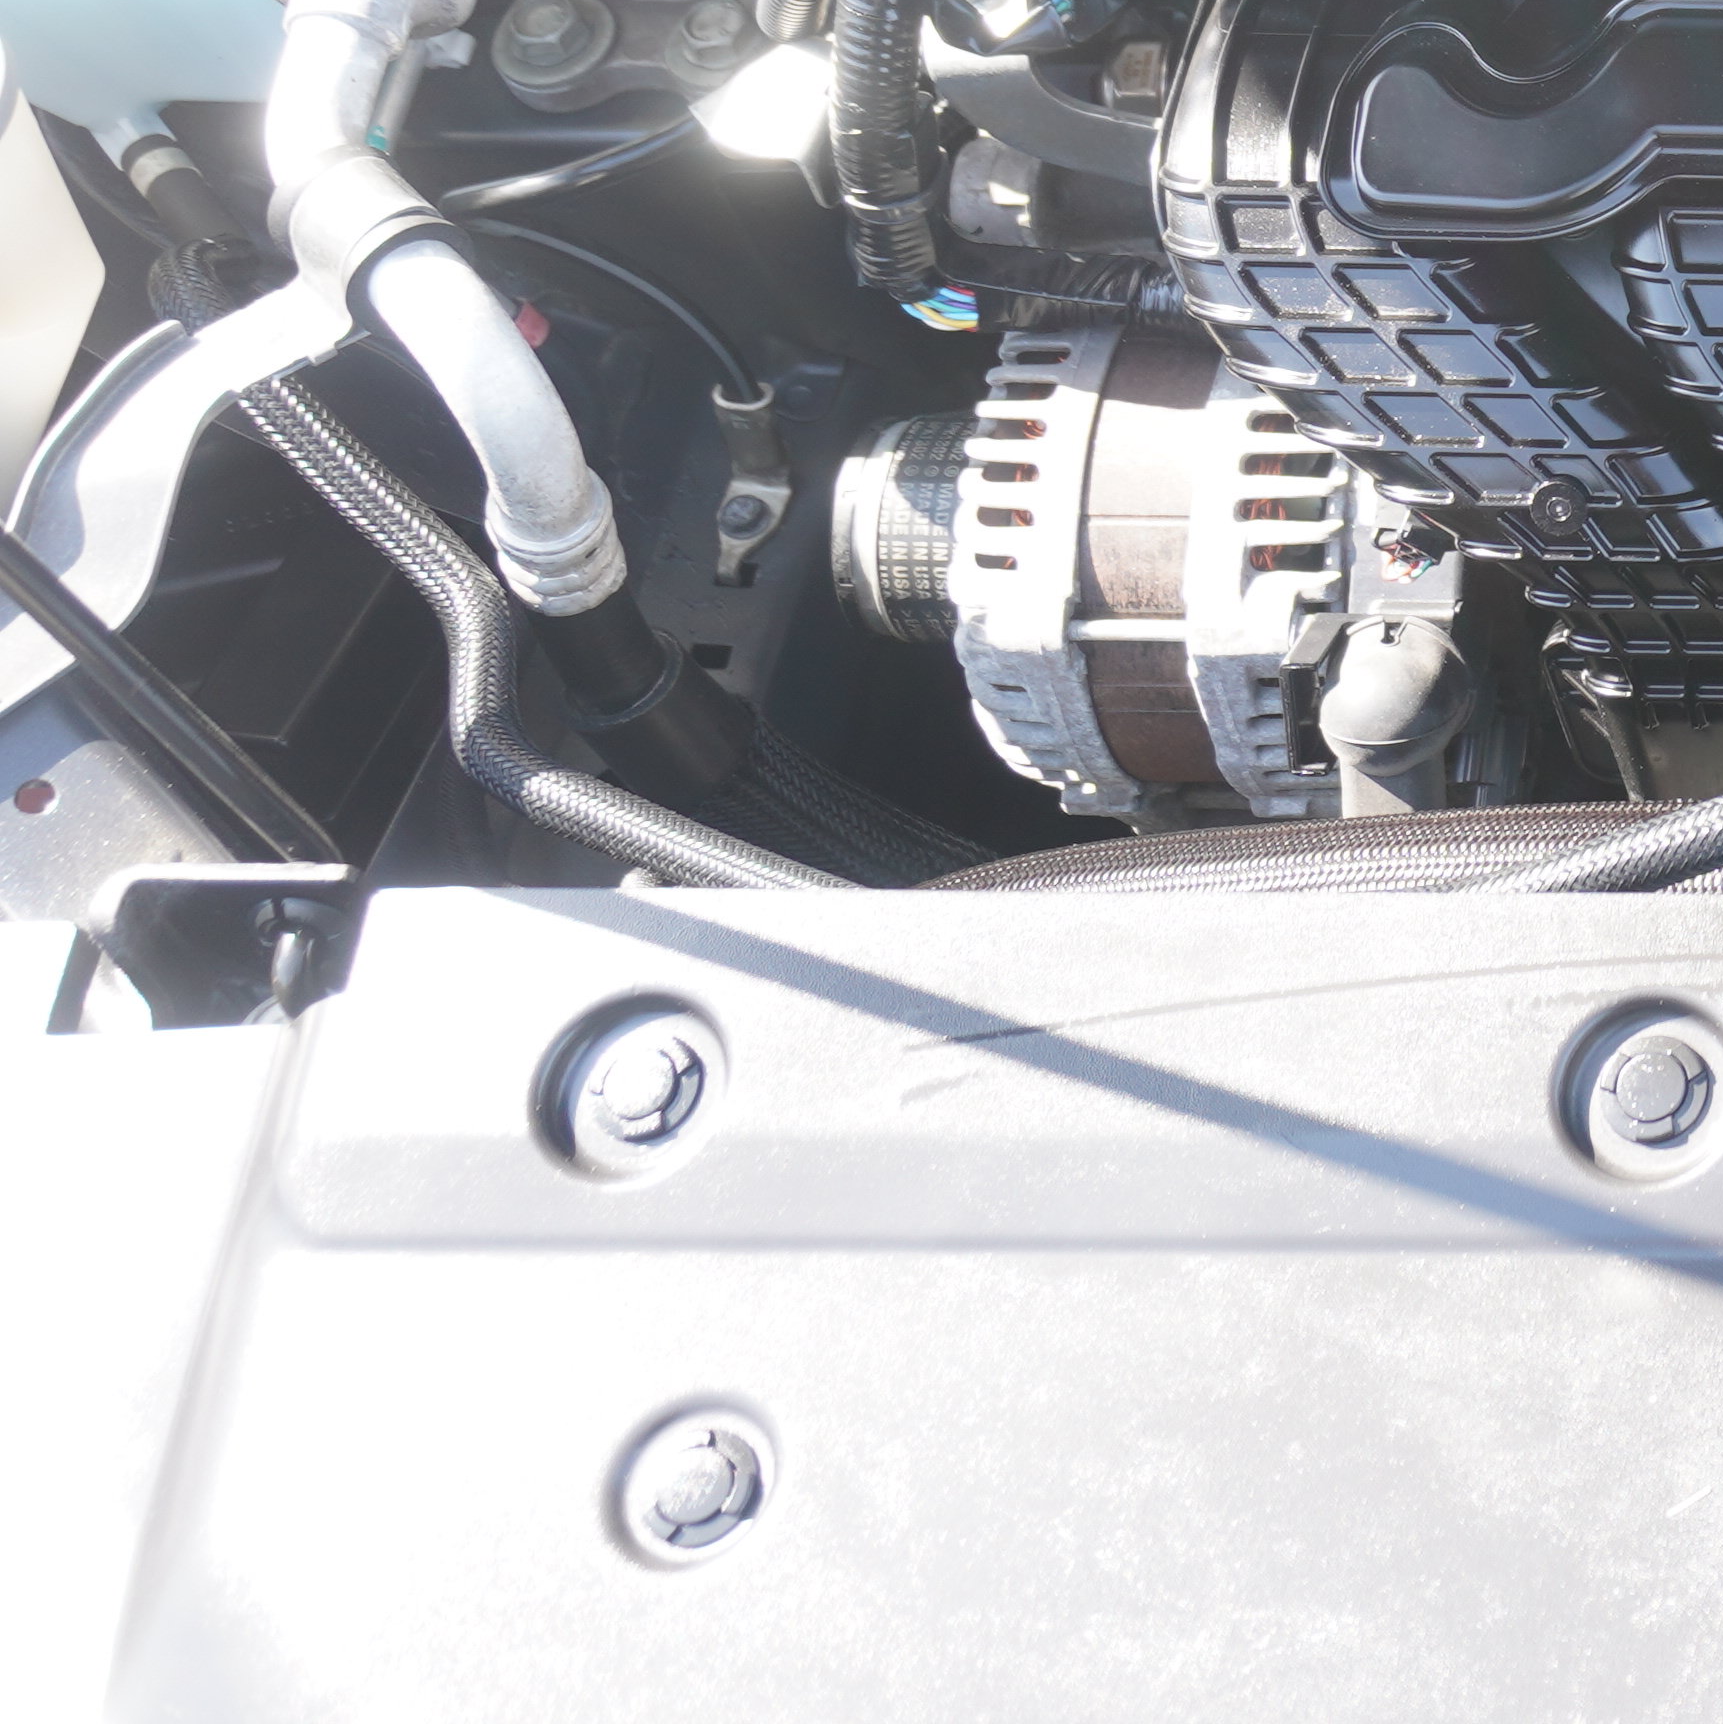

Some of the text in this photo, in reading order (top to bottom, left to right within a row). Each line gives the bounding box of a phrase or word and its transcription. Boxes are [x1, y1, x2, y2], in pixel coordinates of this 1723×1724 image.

[892, 541, 909, 561] IN
[912, 541, 929, 561] IN
[932, 482, 955, 601] MADE IN USA
[892, 565, 913, 600] USA
[912, 566, 933, 600] USA
